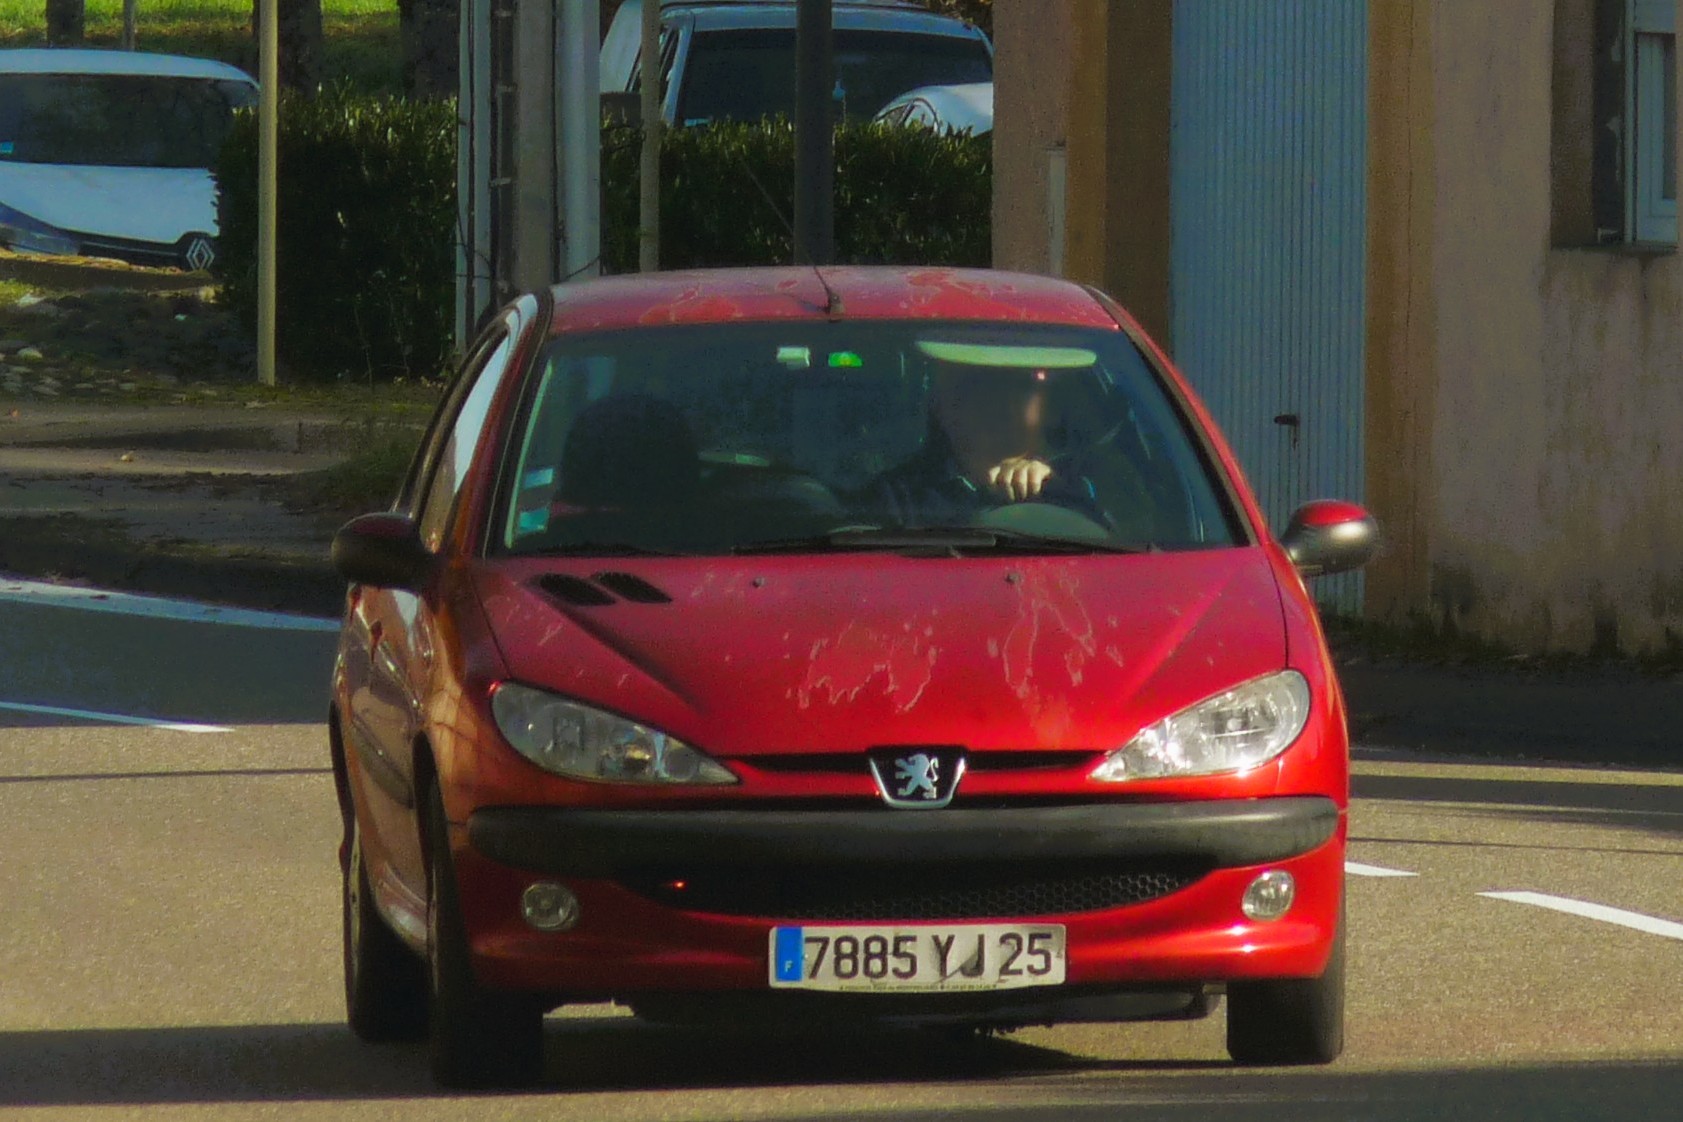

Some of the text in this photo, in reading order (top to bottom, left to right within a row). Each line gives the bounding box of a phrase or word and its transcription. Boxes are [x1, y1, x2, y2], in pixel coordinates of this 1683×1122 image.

[784, 960, 793, 973] F
[803, 932, 1053, 979] 7885 YJ 25
